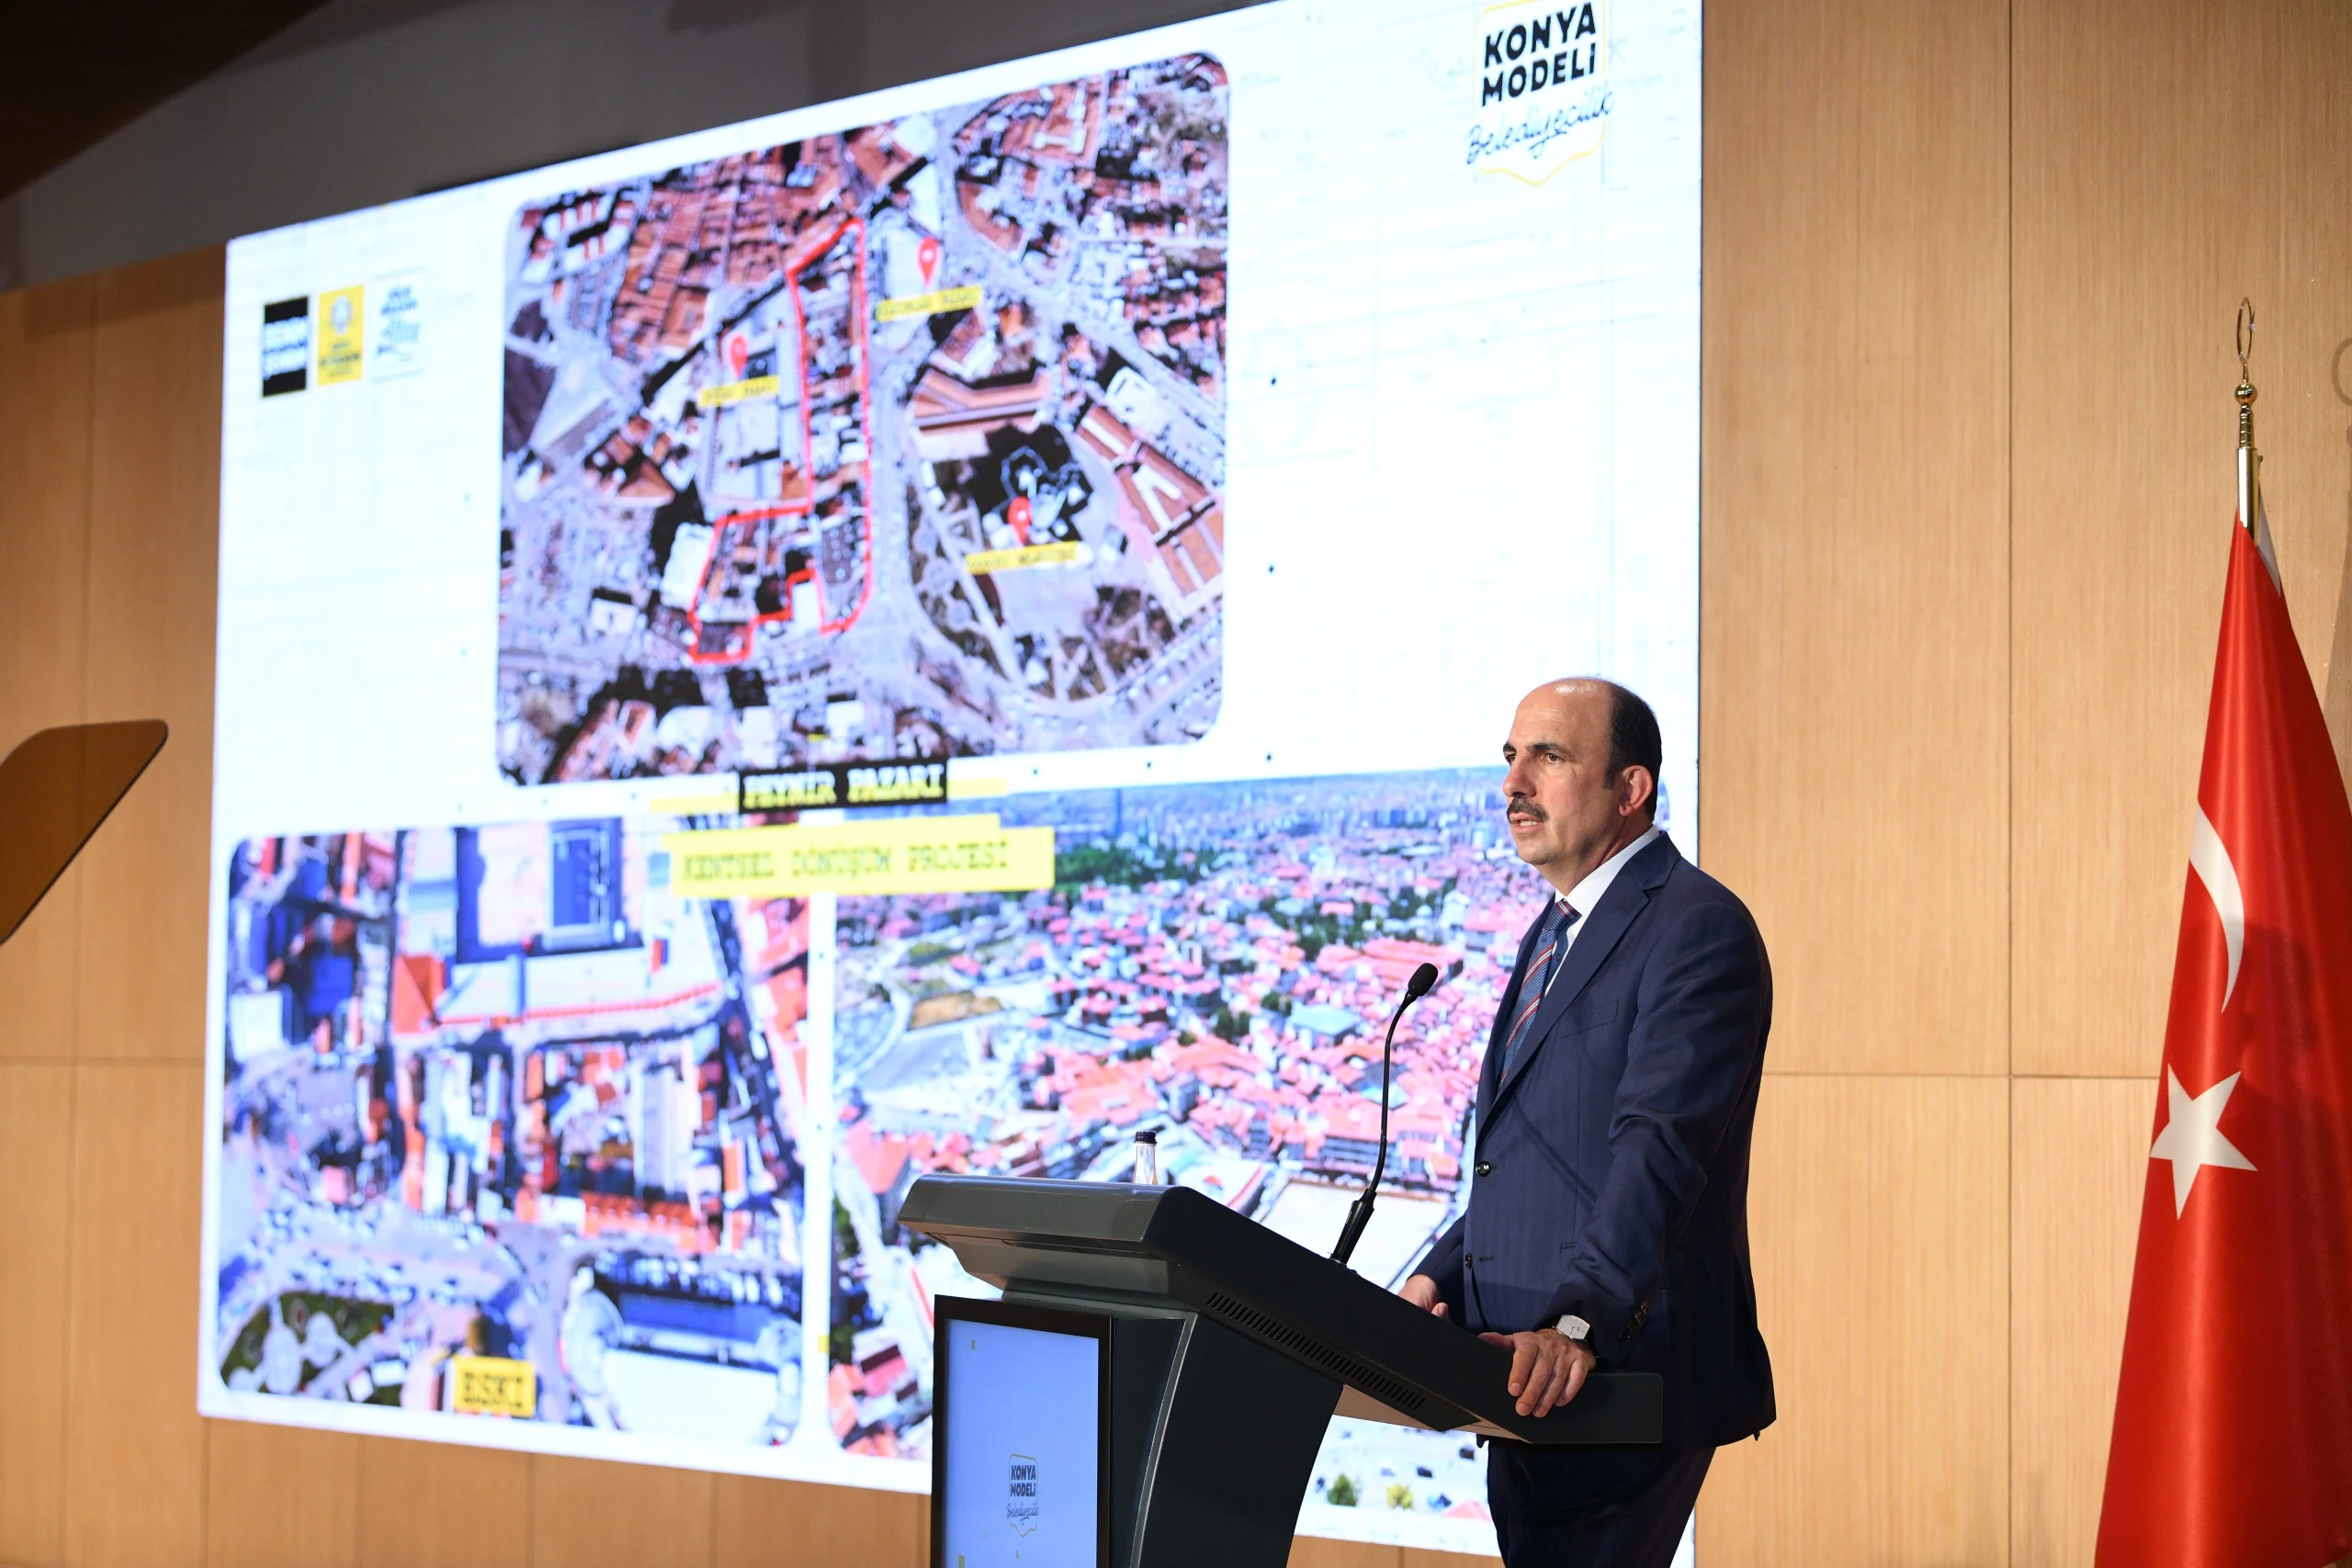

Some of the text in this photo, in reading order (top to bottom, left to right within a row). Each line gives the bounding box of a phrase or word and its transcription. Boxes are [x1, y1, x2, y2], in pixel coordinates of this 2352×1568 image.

[1485, 2, 1597, 69] KONYA
[847, 763, 944, 804] PAZARI
[1011, 1464, 1036, 1481] KONYA
